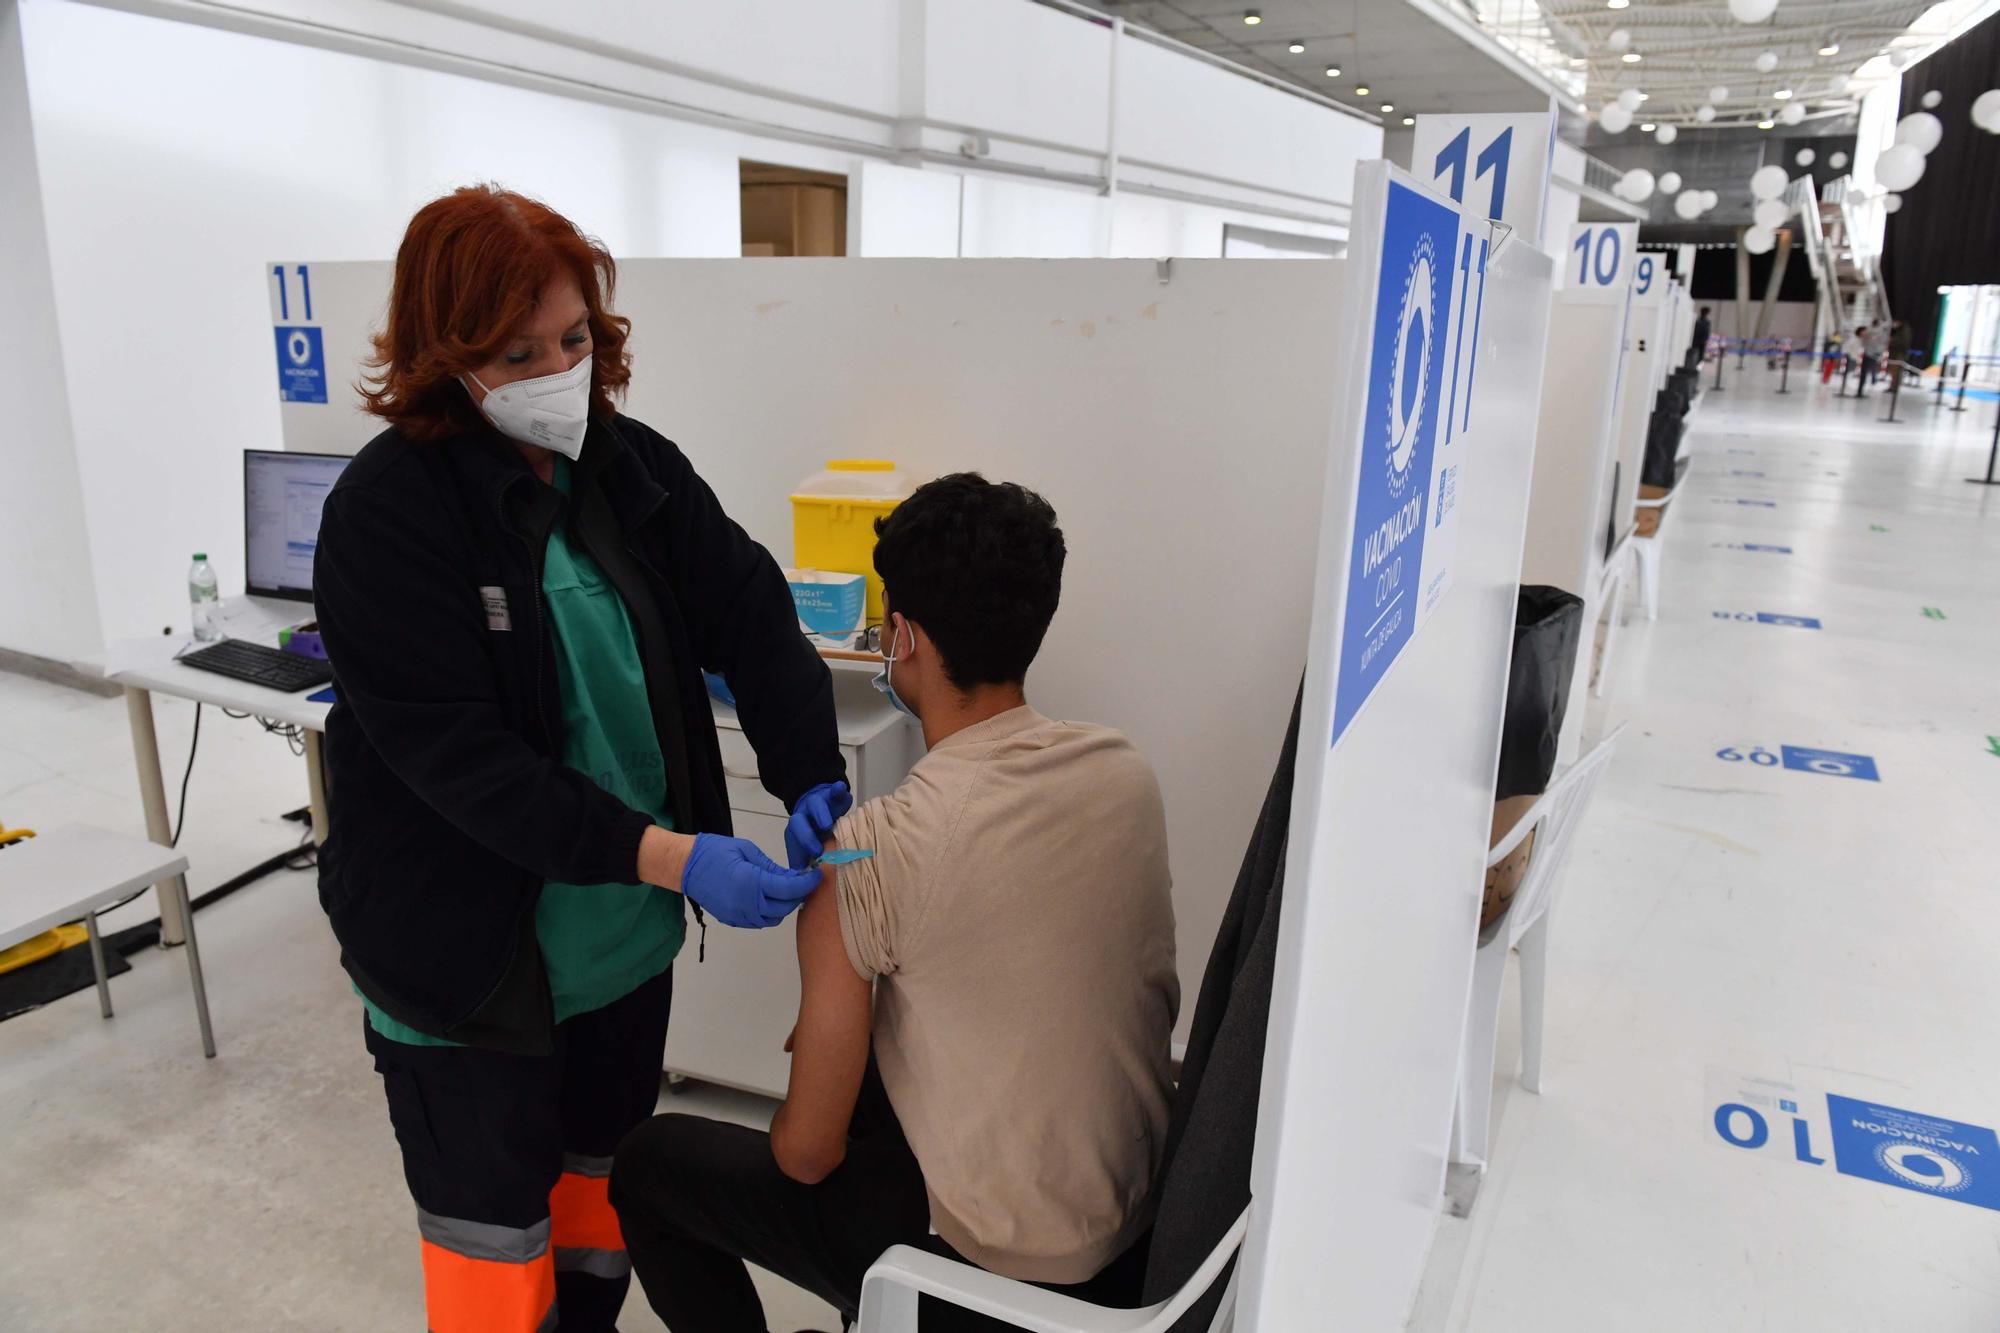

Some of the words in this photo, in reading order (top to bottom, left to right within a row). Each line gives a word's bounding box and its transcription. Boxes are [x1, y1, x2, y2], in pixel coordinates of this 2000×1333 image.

[1434, 126, 1513, 221] 11
[1574, 227, 1621, 286] 10
[1636, 257, 1653, 294] 9
[273, 265, 312, 320] 11
[1445, 232, 1488, 445] 11
[1363, 486, 1422, 578] VACINACIÓN
[1376, 557, 1401, 608] COVID
[1714, 1103, 1826, 1165] 10
[1852, 1119, 1980, 1155] VACINACIÓN
[1887, 1119, 1941, 1137] COVID
